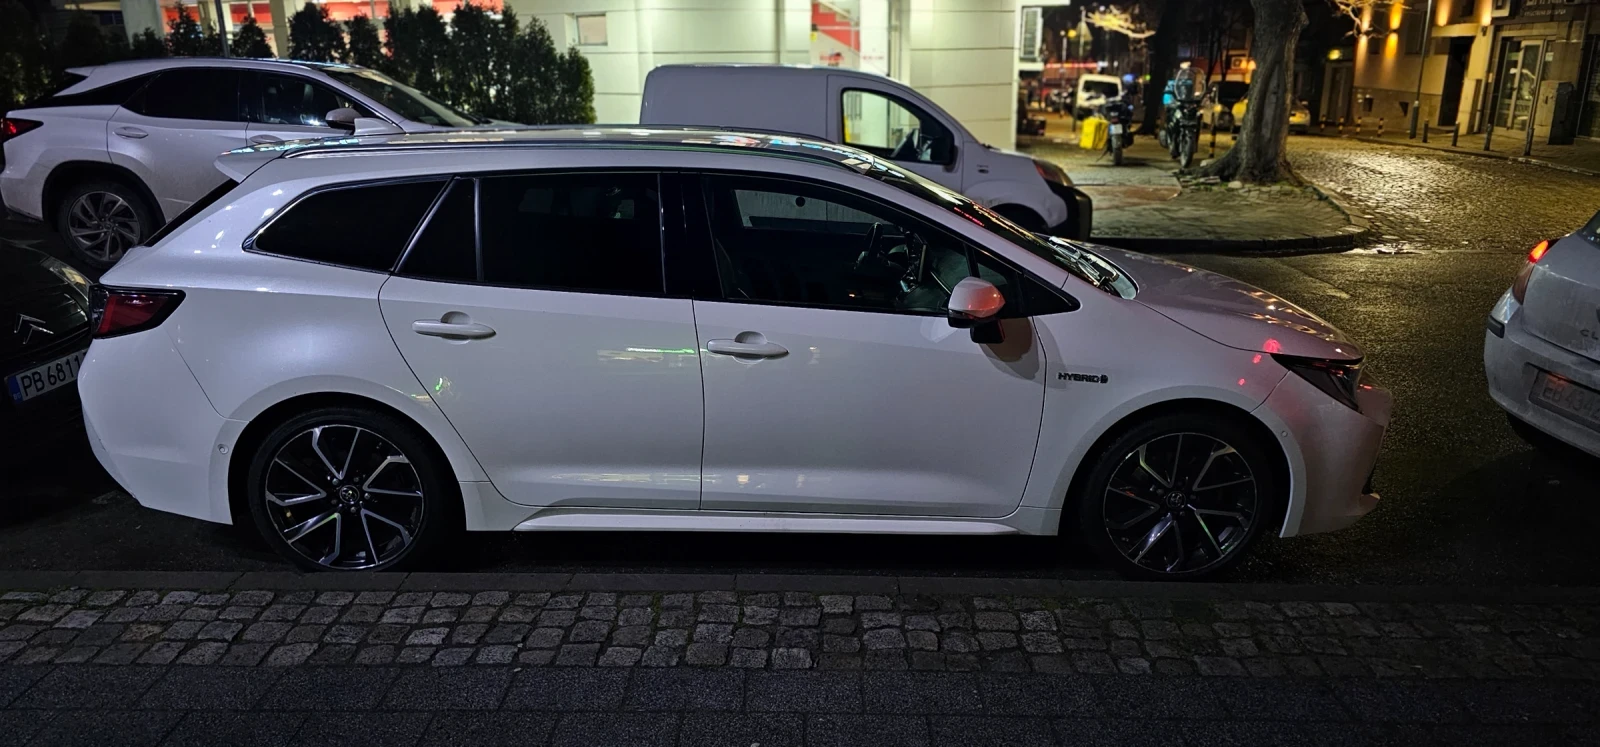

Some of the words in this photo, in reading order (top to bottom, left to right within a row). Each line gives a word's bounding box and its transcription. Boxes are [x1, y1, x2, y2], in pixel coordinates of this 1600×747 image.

[21, 371, 45, 397] PB
[47, 355, 82, 386] 6811
[1058, 372, 1100, 383] HYBRID
